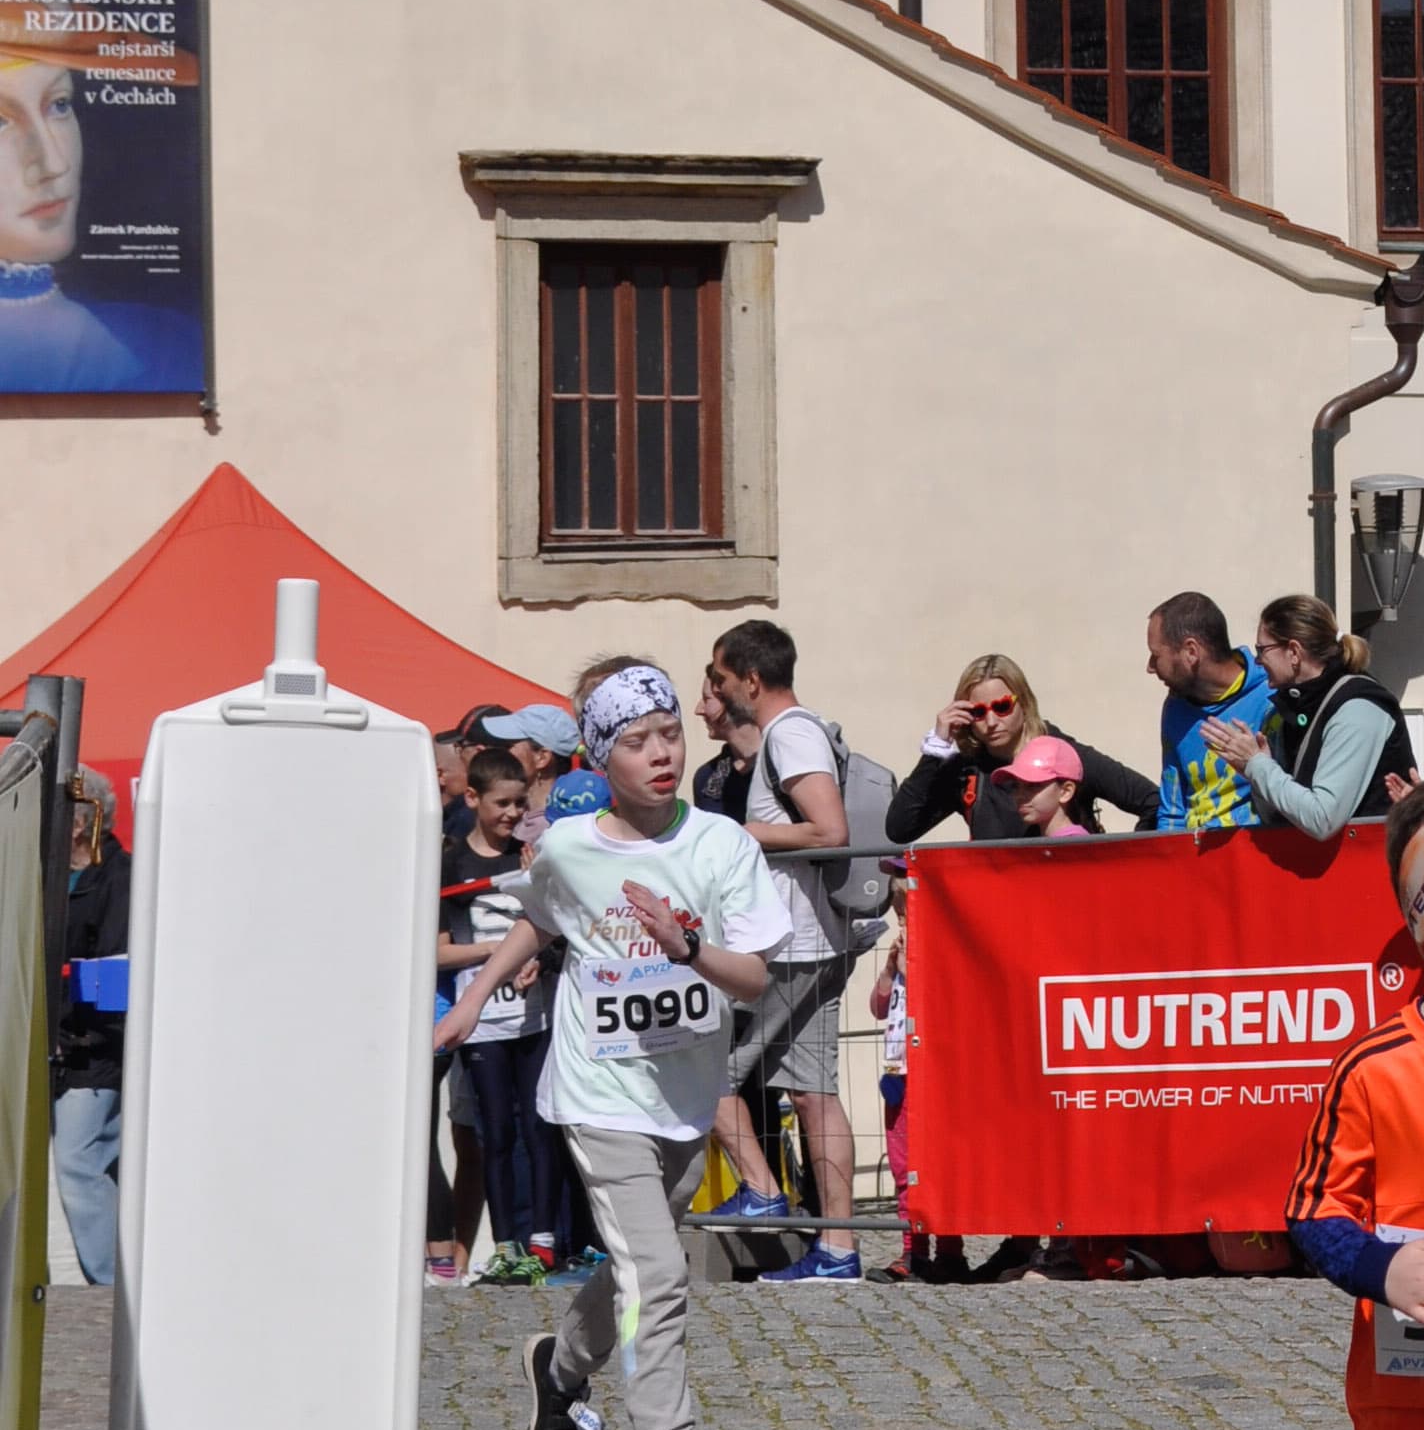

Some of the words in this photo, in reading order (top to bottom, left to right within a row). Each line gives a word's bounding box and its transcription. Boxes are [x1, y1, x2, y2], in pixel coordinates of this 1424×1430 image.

[24, 10, 176, 33] REZIDENCE
[98, 40, 176, 59] nejstarší
[86, 67, 176, 82] renesance
[84, 91, 97, 104] v
[101, 84, 176, 105] Čechách
[596, 982, 709, 1034] 5090
[1061, 987, 1355, 1051] NUTREND
[1050, 1089, 1097, 1110] THE
[1105, 1086, 1193, 1109] POWER
[1201, 1085, 1233, 1107] OF
